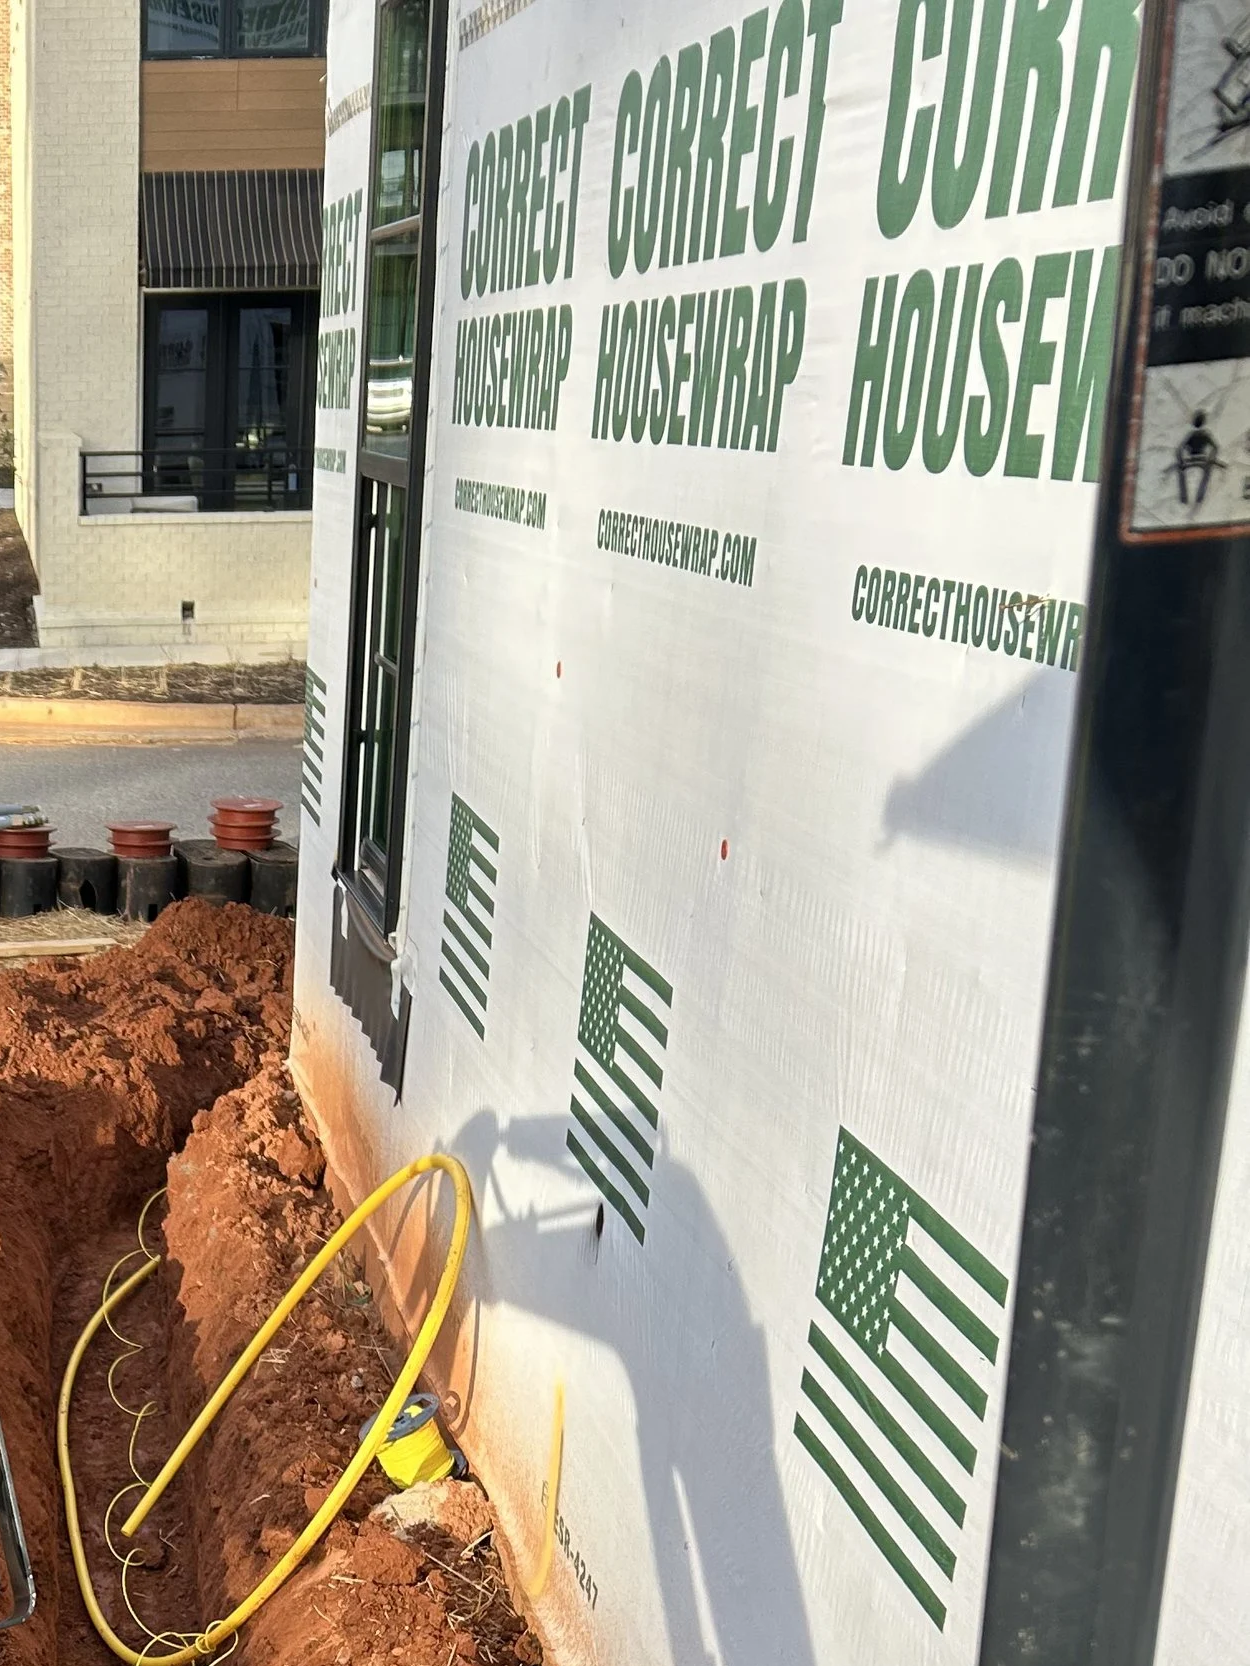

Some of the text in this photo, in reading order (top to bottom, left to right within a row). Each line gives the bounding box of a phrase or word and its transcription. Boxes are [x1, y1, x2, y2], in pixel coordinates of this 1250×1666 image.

[460, 83, 592, 300] CORRECT
[608, 0, 844, 279] CORRECT
[1154, 246, 1250, 287] DO NO
[452, 303, 573, 431] HOUSEWRAP
[591, 277, 808, 452] HOUSEWRAP
[842, 244, 1123, 483] HOUSEW
[455, 477, 548, 530] CORRECTHOUSEWRAP.COM
[597, 508, 757, 588] CORRECTHOUSEWRAP.COM
[851, 564, 1087, 672] CORRECTHOUSEWR
[554, 1508, 598, 1611] ESR-4247
